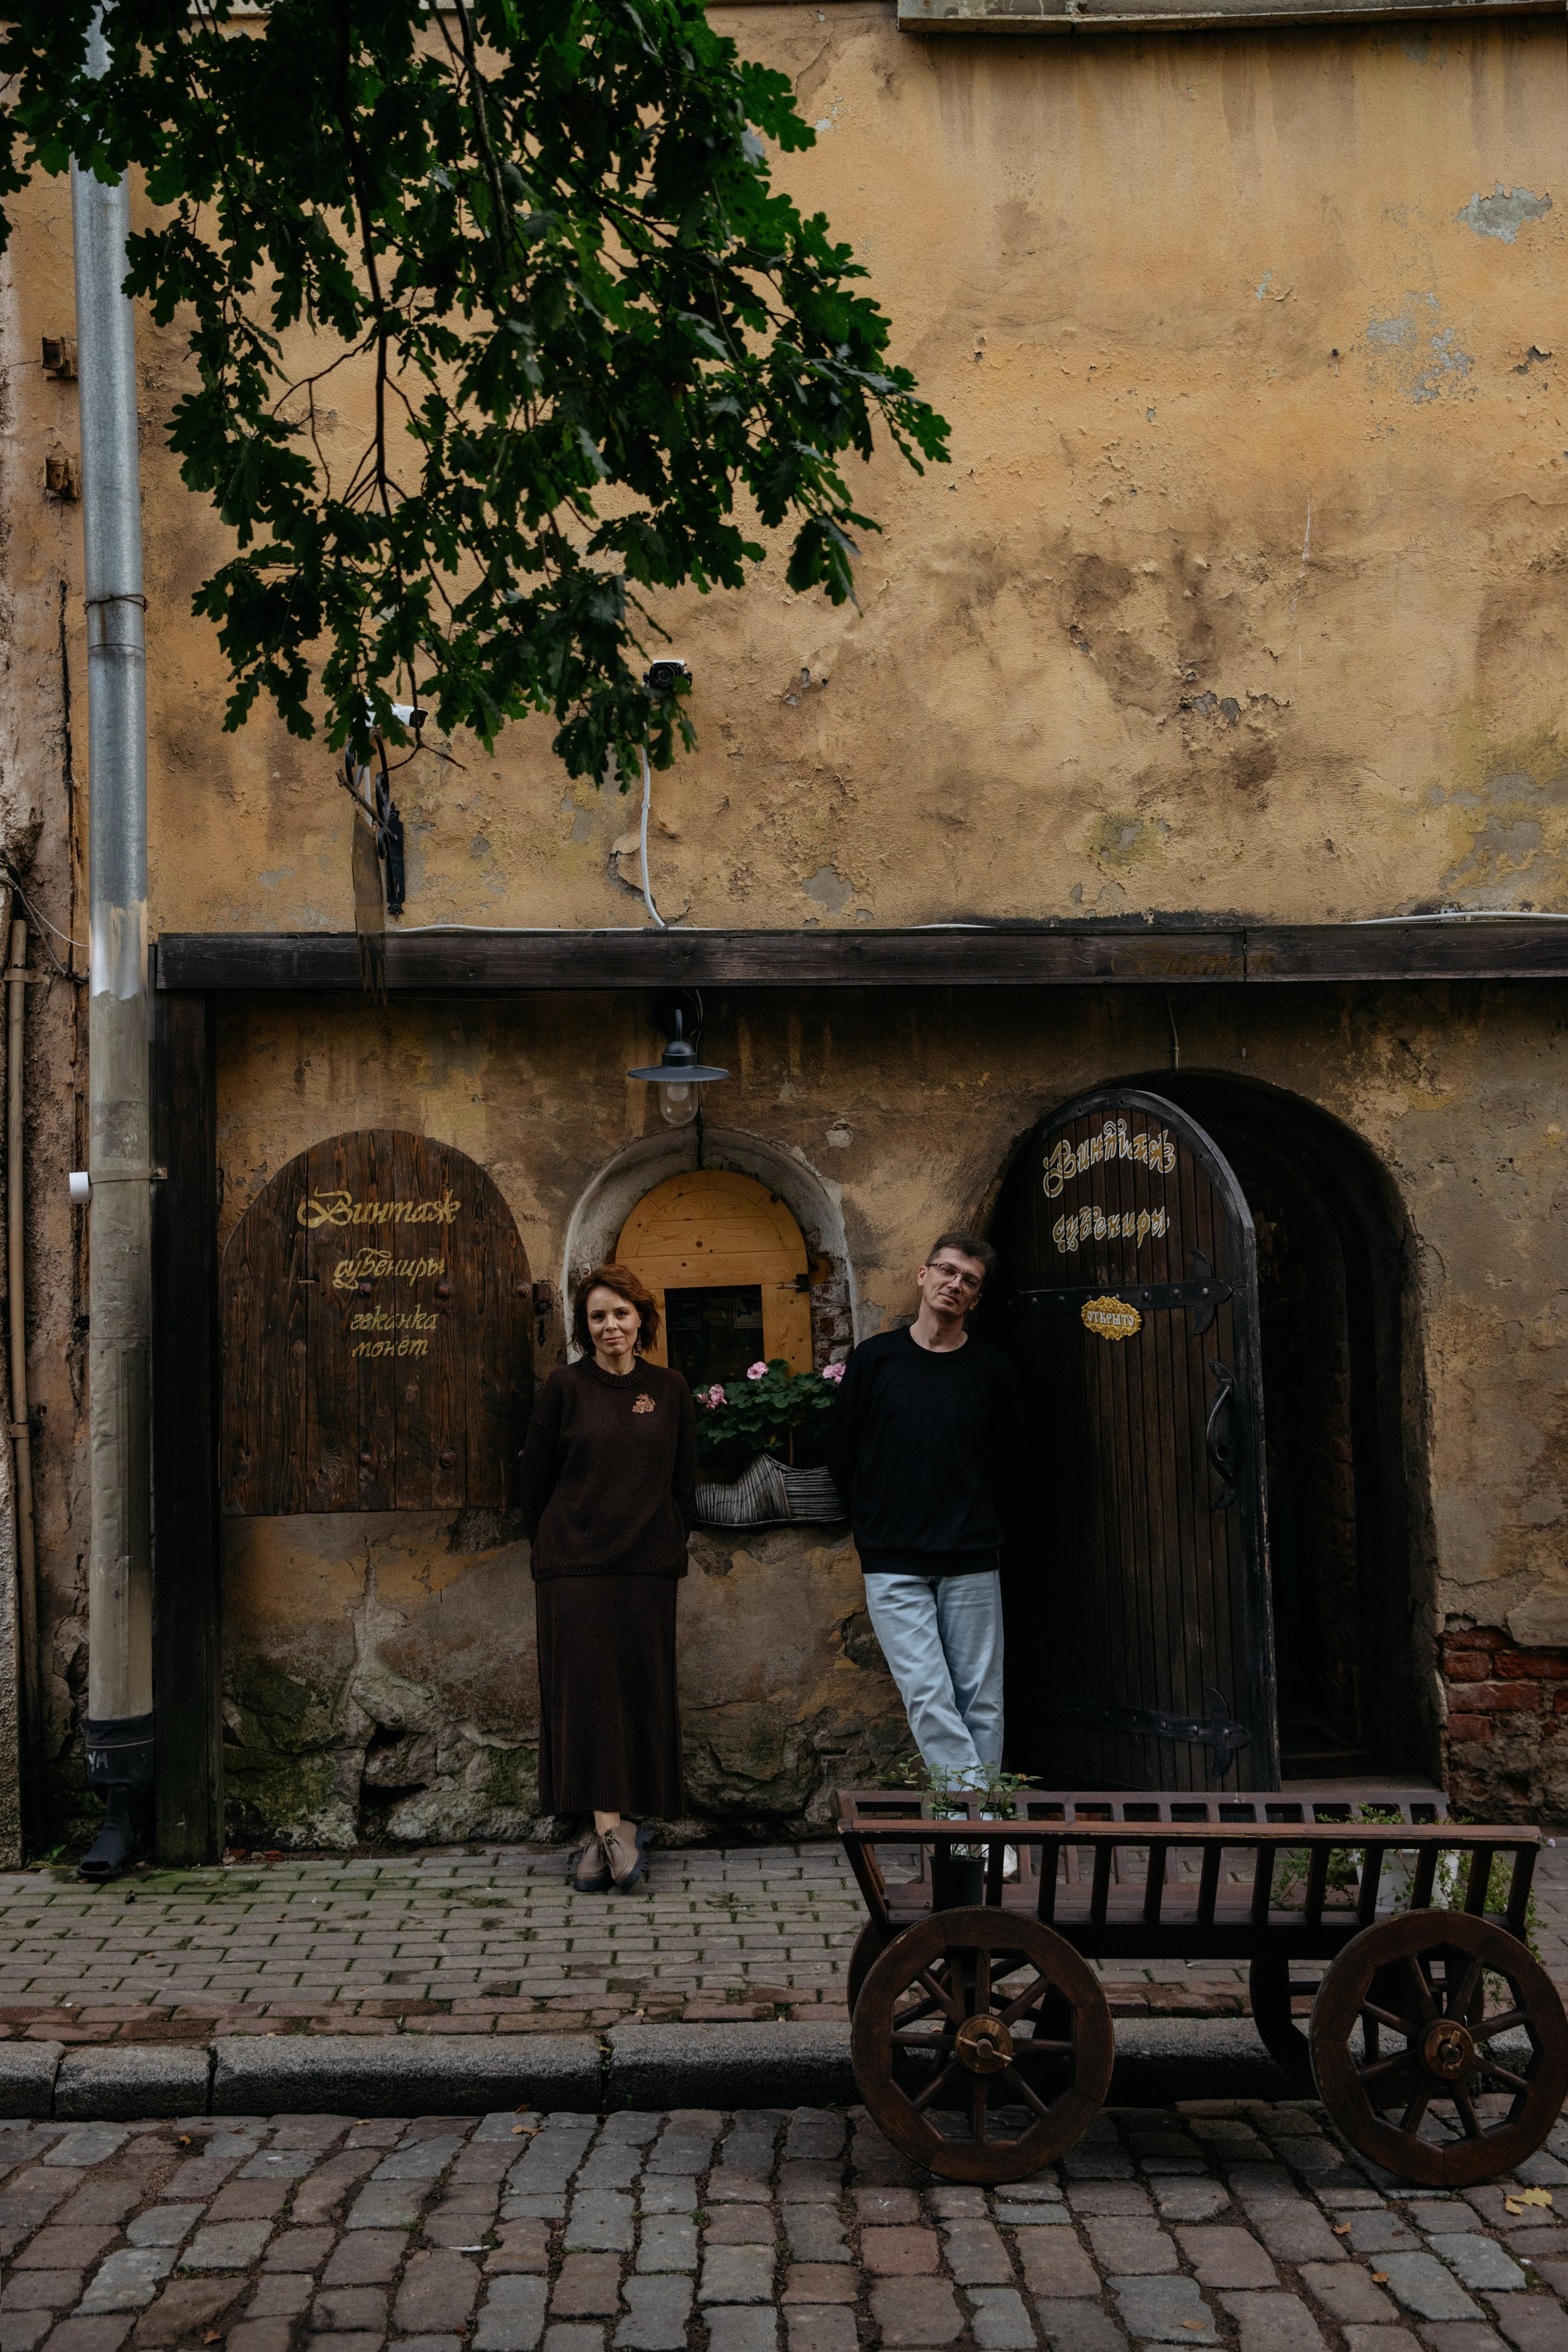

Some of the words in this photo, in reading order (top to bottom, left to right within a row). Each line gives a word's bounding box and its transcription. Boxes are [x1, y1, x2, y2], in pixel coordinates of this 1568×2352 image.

[1043, 1118, 1176, 1198] Винтаж
[297, 1187, 462, 1228] Винтаж
[1052, 1205, 1169, 1253] сувениры
[332, 1247, 446, 1289] сувениры
[1087, 1311, 1134, 1327] ОТКРЫТО
[352, 1338, 429, 1359] монет
